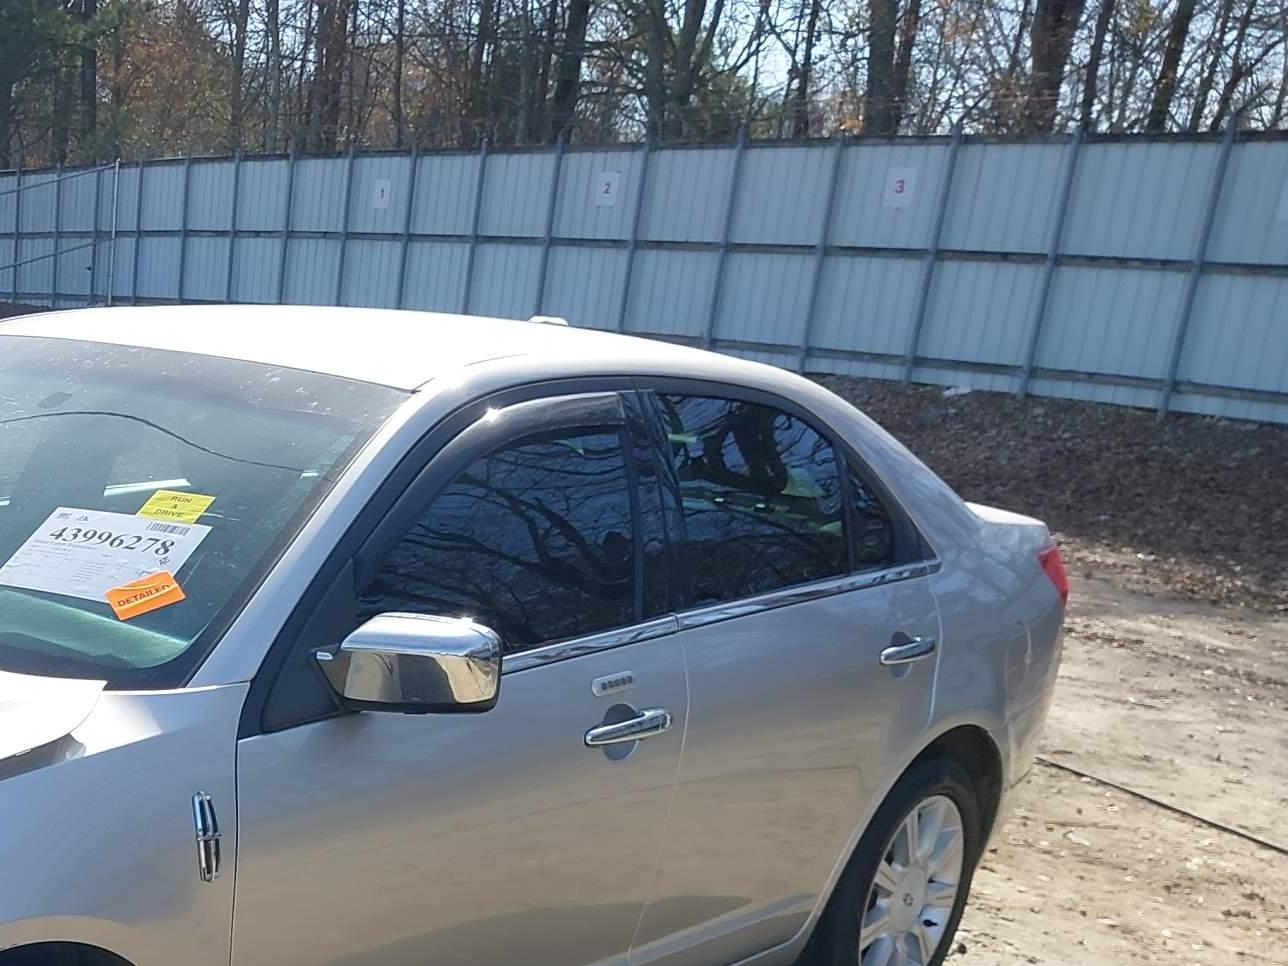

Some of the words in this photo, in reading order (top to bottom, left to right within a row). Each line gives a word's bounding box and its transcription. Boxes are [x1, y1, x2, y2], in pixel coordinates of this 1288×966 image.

[603, 182, 612, 194] 2
[895, 180, 905, 194] 3
[170, 495, 192, 503] RUN
[153, 508, 184, 518] DRIVE
[49, 526, 175, 556] 43996278
